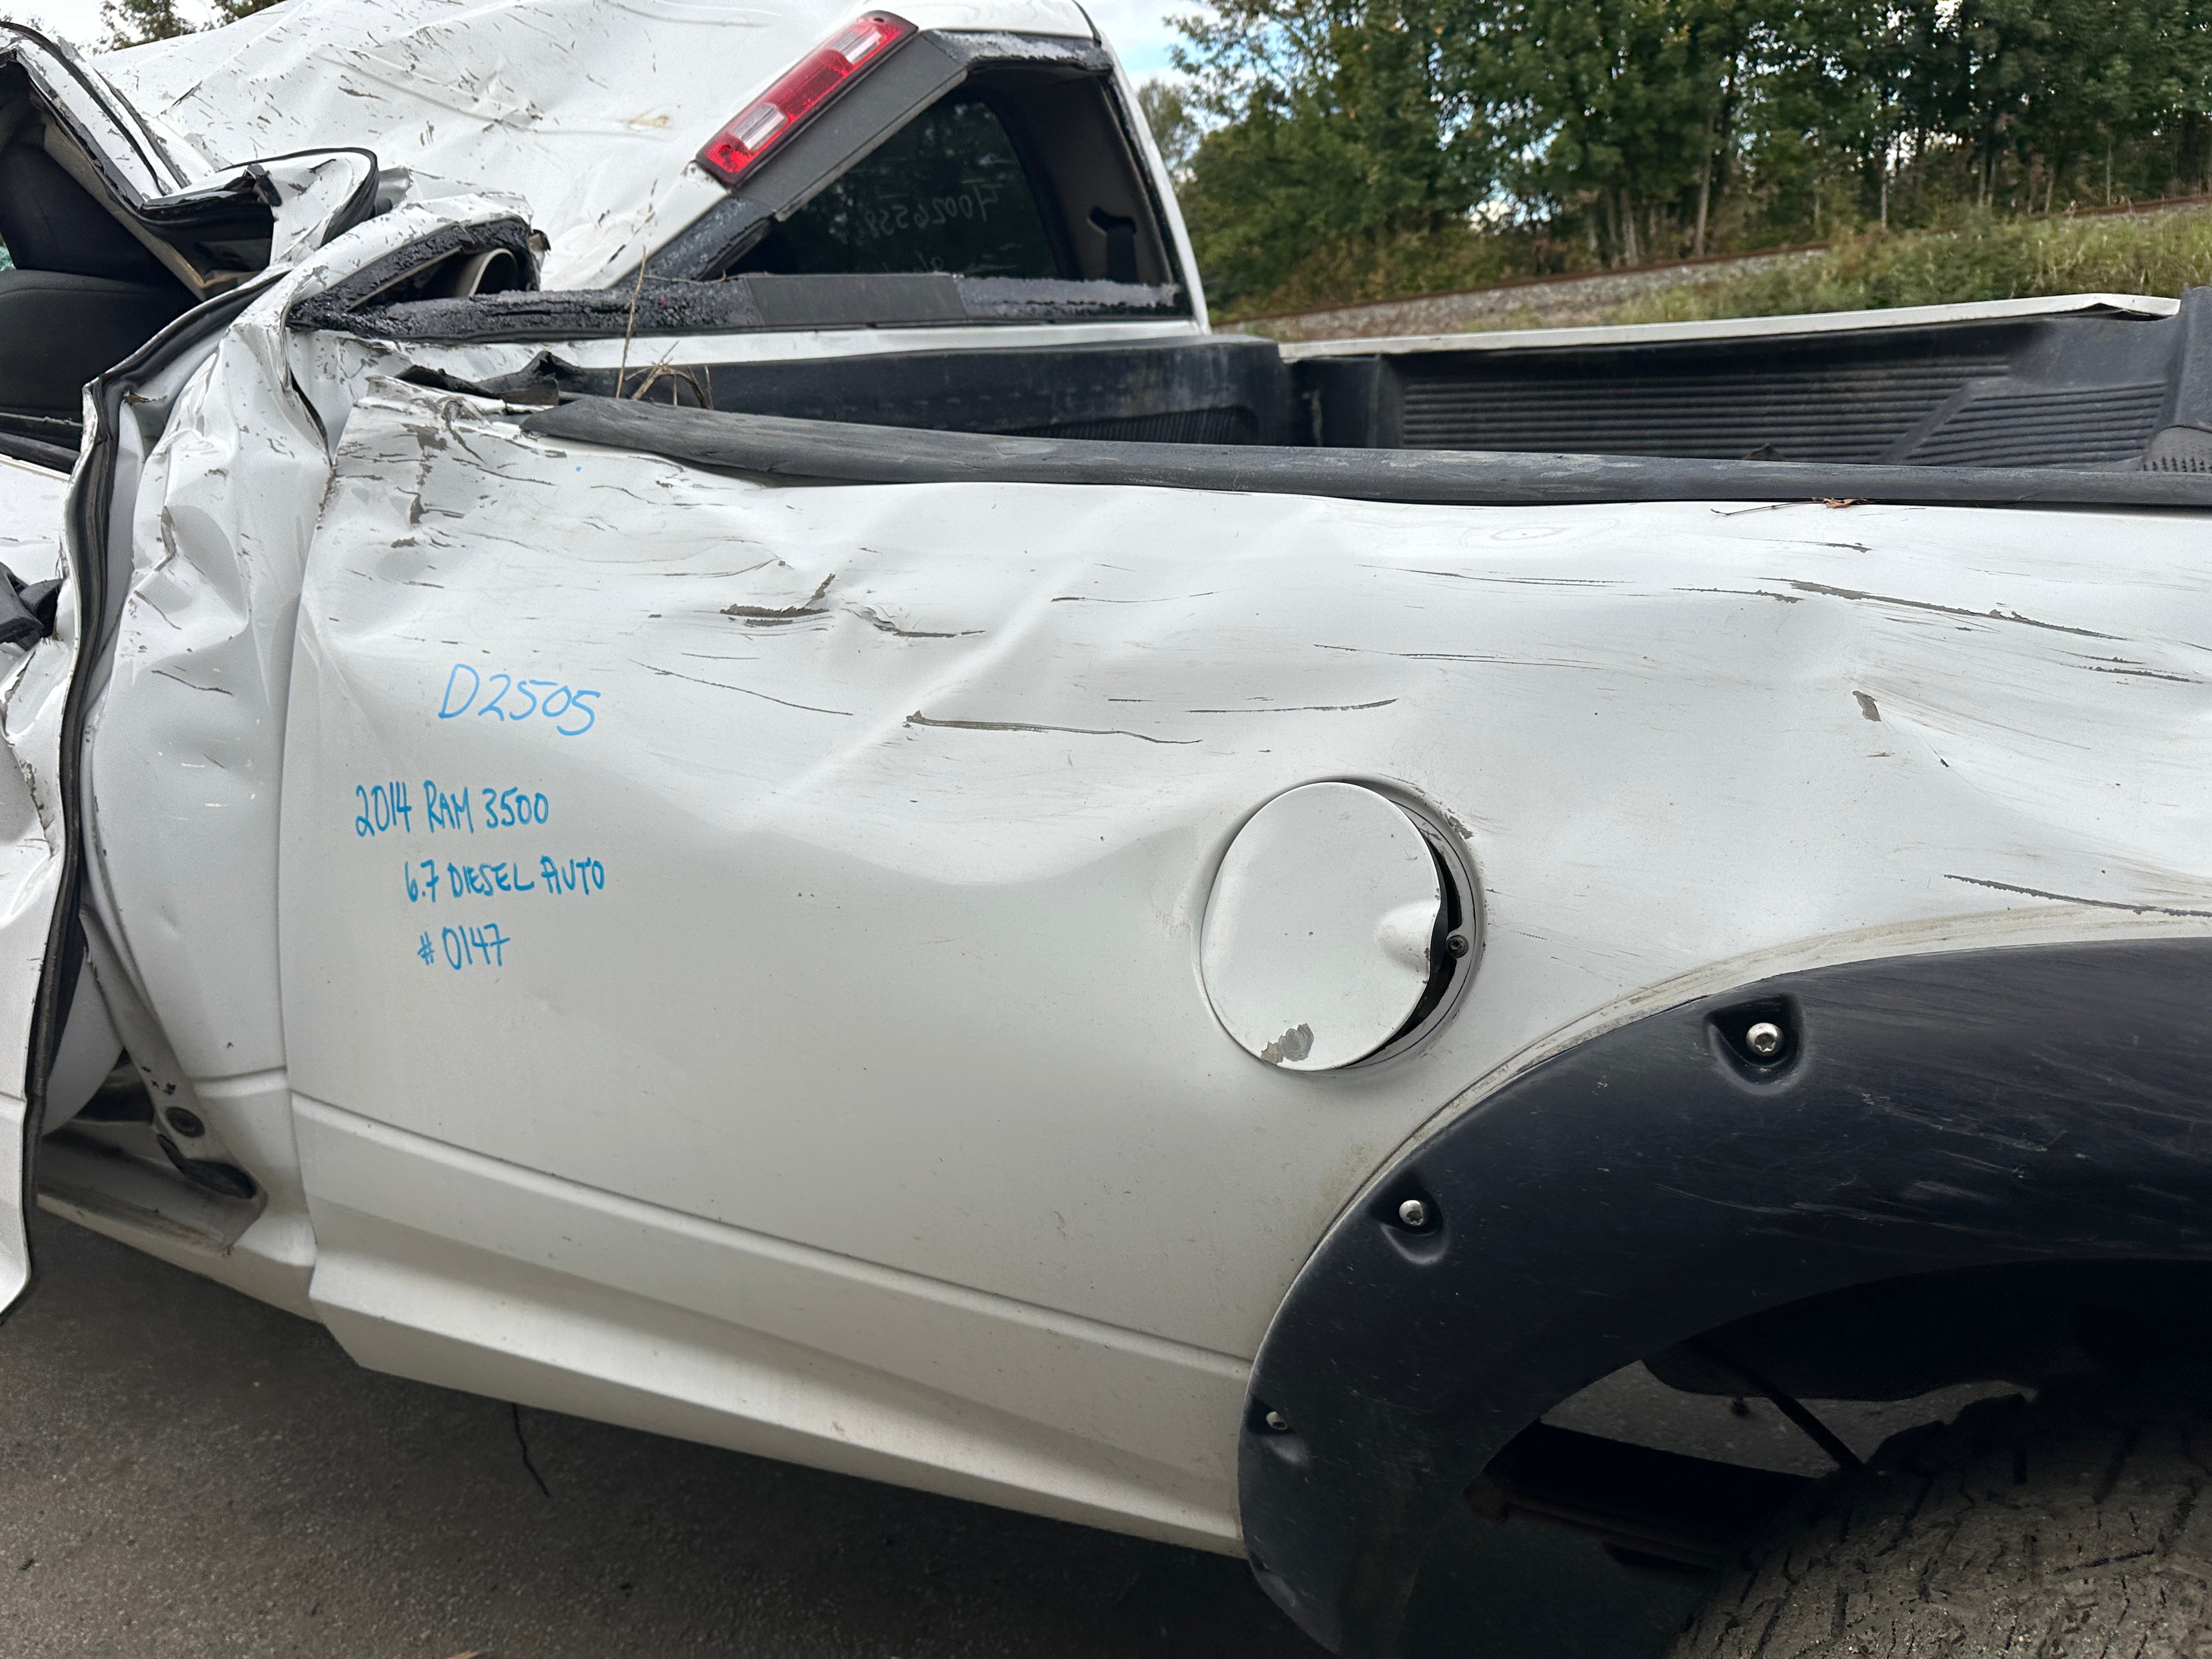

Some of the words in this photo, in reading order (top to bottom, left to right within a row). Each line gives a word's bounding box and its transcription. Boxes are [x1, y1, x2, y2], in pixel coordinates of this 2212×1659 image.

[438, 664, 601, 736] D2505
[355, 781, 412, 837] 2014
[423, 780, 474, 834] RAM
[482, 786, 549, 829] 3500
[404, 859, 440, 903] 6.7
[448, 855, 535, 897] DIESEL
[540, 855, 605, 895] AUTO
